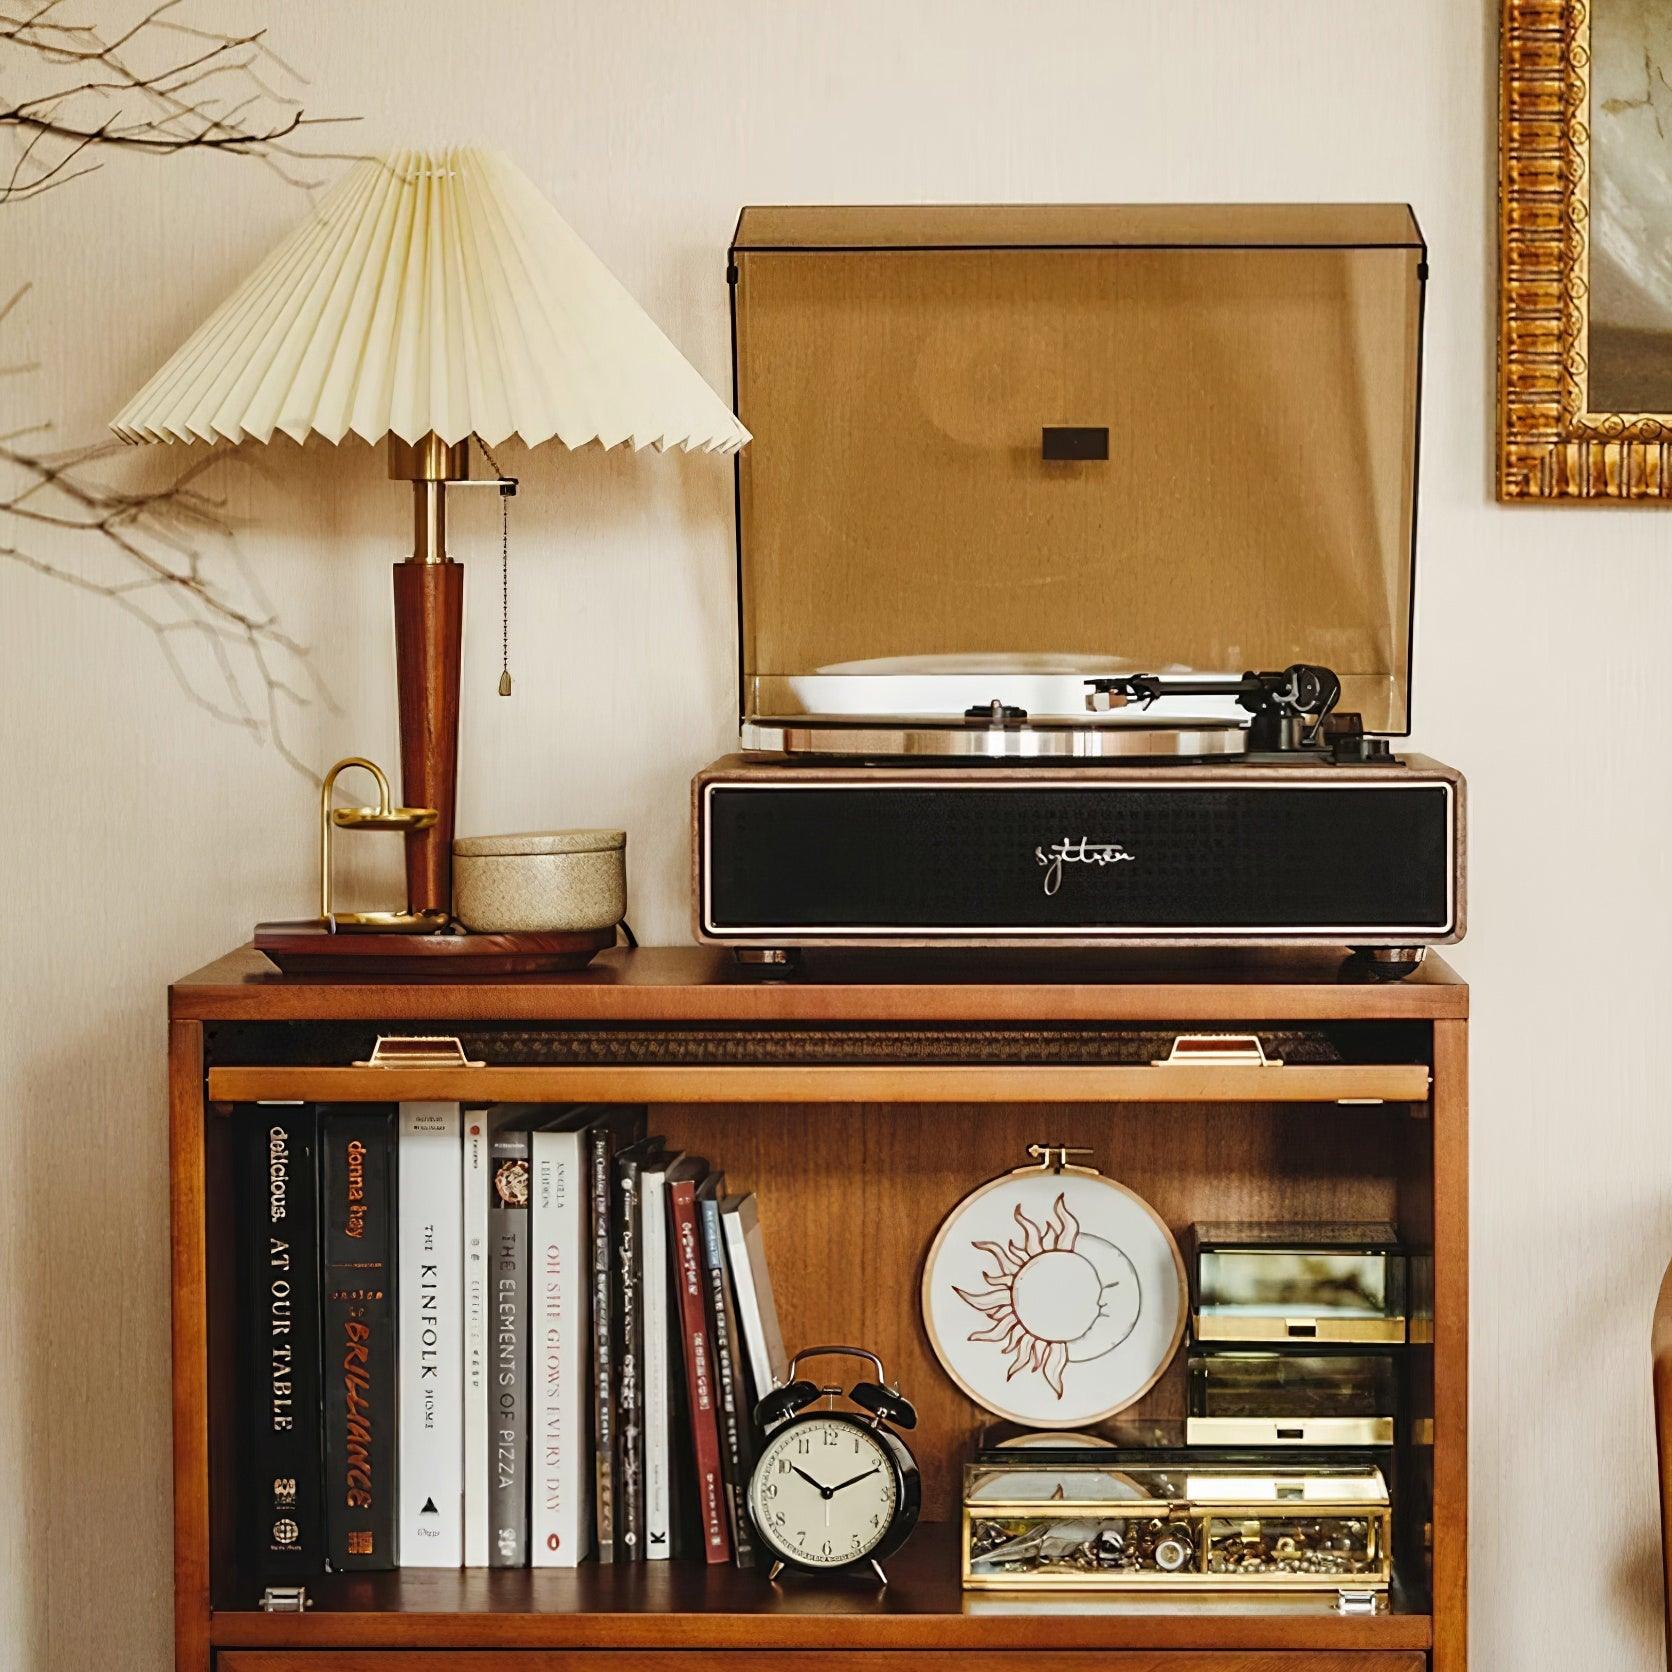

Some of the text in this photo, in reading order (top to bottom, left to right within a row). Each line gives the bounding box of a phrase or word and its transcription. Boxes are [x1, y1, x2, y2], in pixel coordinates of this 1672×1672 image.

[347, 1140, 367, 1200] donna
[344, 1205, 367, 1238] hay
[270, 1238, 290, 1271] AT
[547, 1244, 560, 1275] OH
[271, 1279, 291, 1336] OUR
[421, 1264, 437, 1380] KINFOLK
[498, 1233, 516, 1489] THE ELEMENTS OF PIZZA
[271, 1344, 292, 1431] TABLE
[344, 1321, 372, 1508] BRILLIANCE
[546, 1406, 560, 1469] EVERY
[799, 1438, 810, 1454] 11
[824, 1430, 838, 1446] 12
[547, 1478, 561, 1513] DAY
[767, 1484, 778, 1500] 9
[881, 1486, 889, 1502] 3
[775, 1511, 786, 1527] 8
[869, 1514, 880, 1528] 4
[650, 1530, 666, 1545] K
[796, 1531, 807, 1546] 7
[822, 1540, 832, 1556] 6
[851, 1534, 861, 1549] 5
